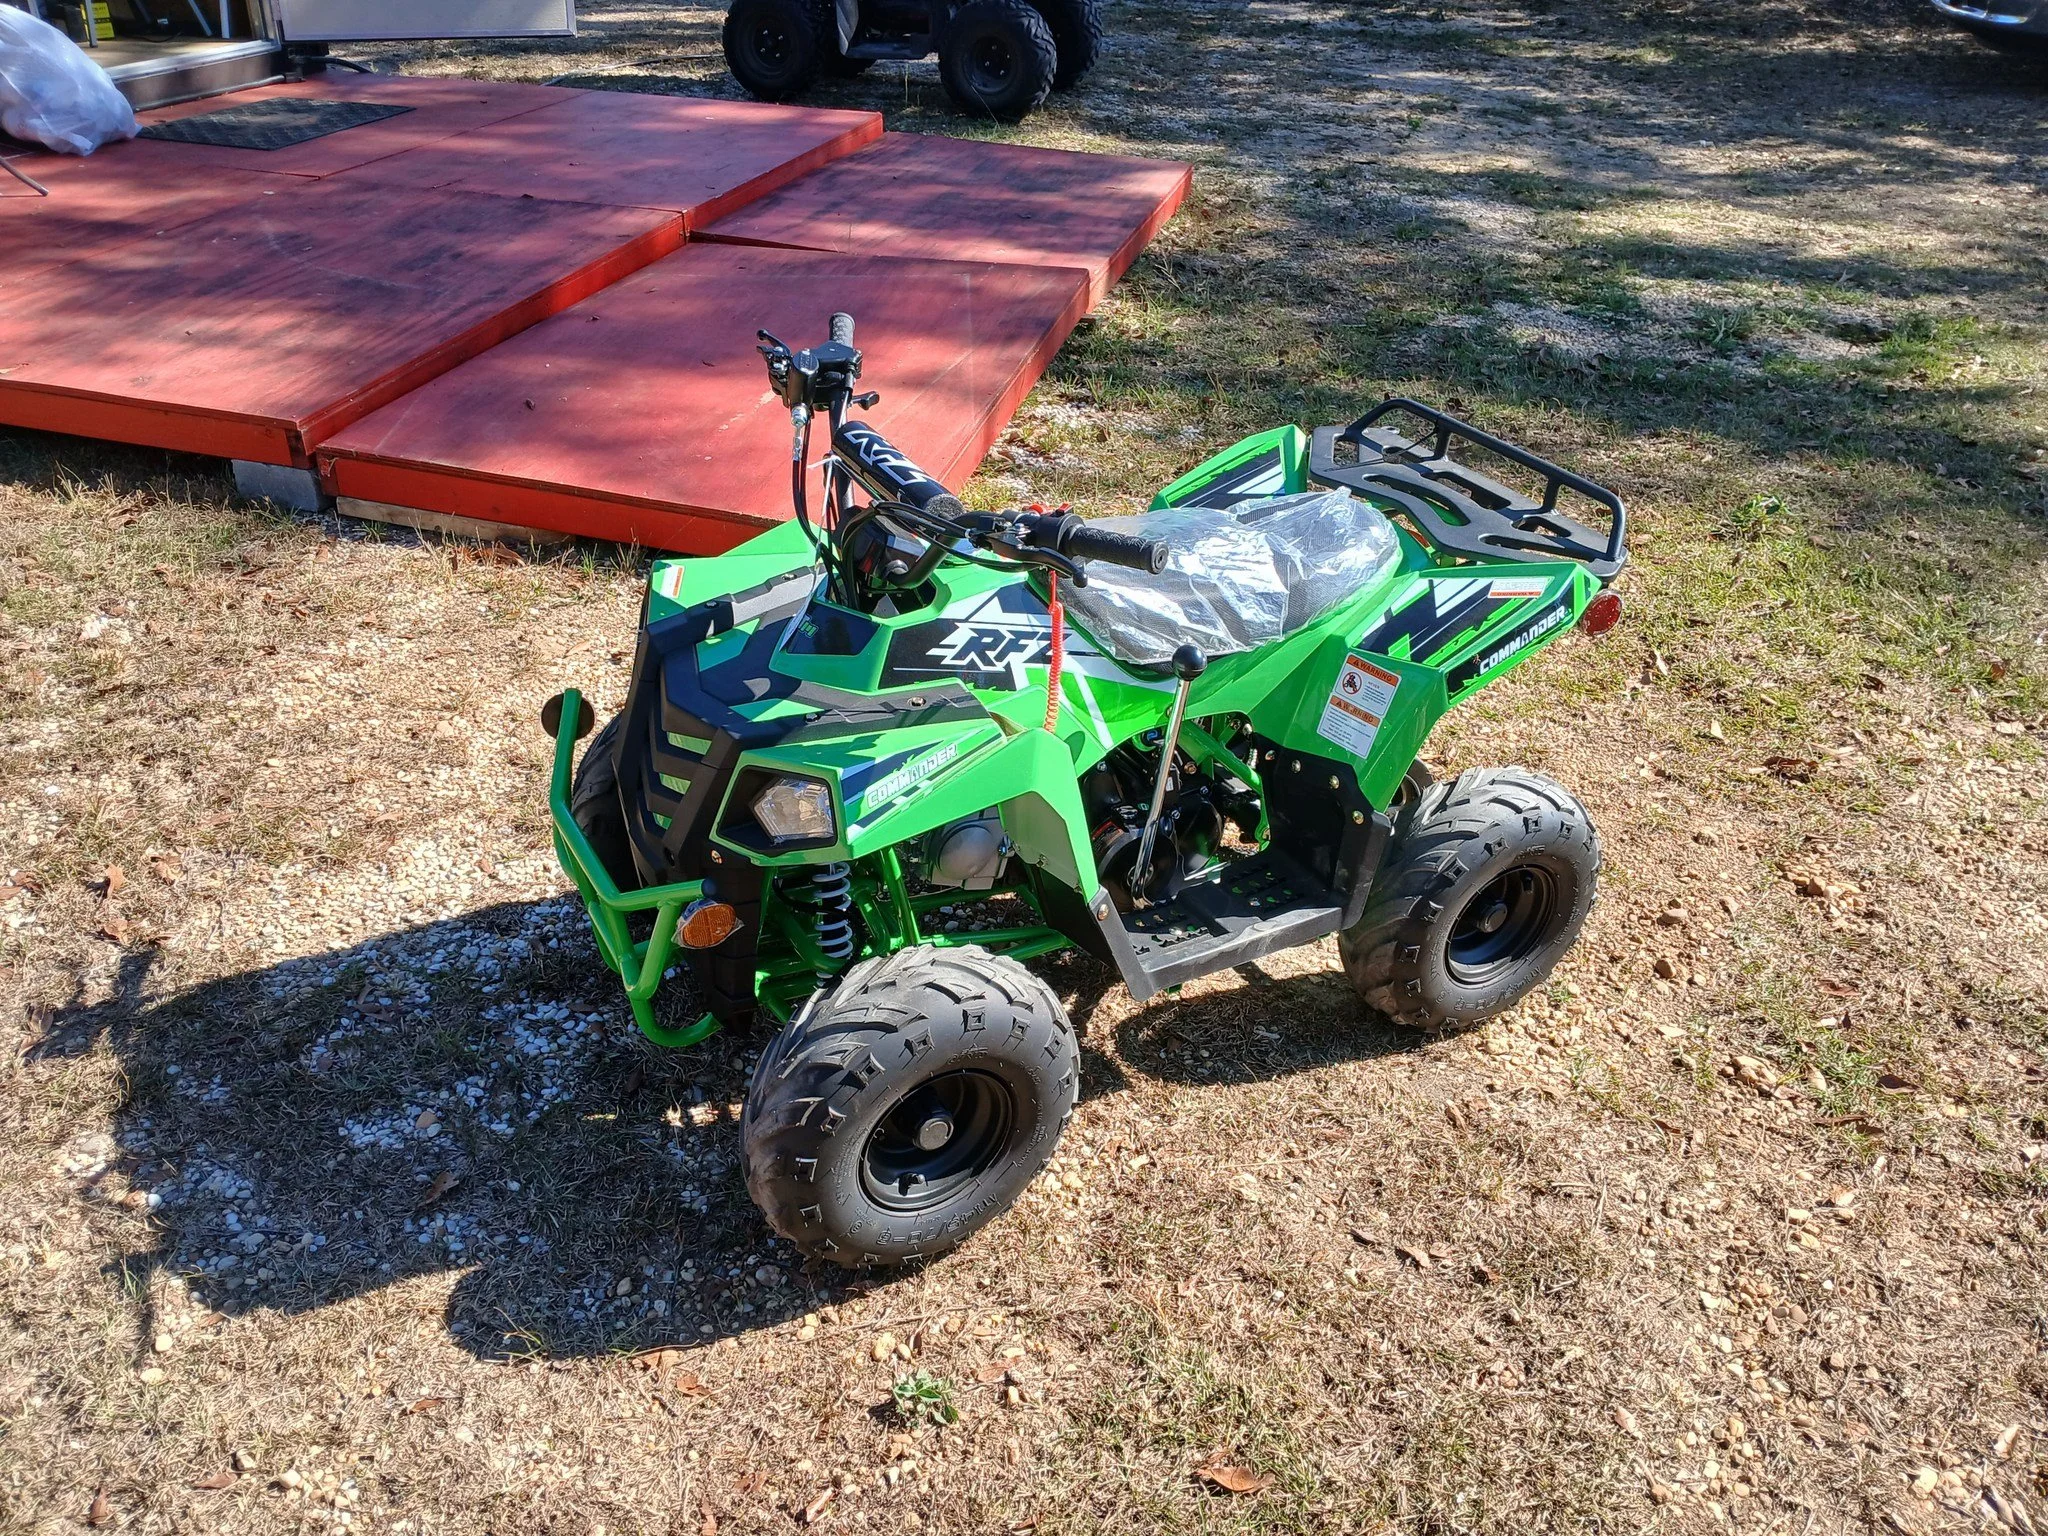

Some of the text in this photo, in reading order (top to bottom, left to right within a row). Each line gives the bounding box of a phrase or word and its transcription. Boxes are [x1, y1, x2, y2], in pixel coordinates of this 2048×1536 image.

[946, 626, 1073, 668] RFZ
[1480, 605, 1566, 675] COMMANDER
[1358, 660, 1392, 682] WARNING
[867, 743, 958, 809] COMMANDER
